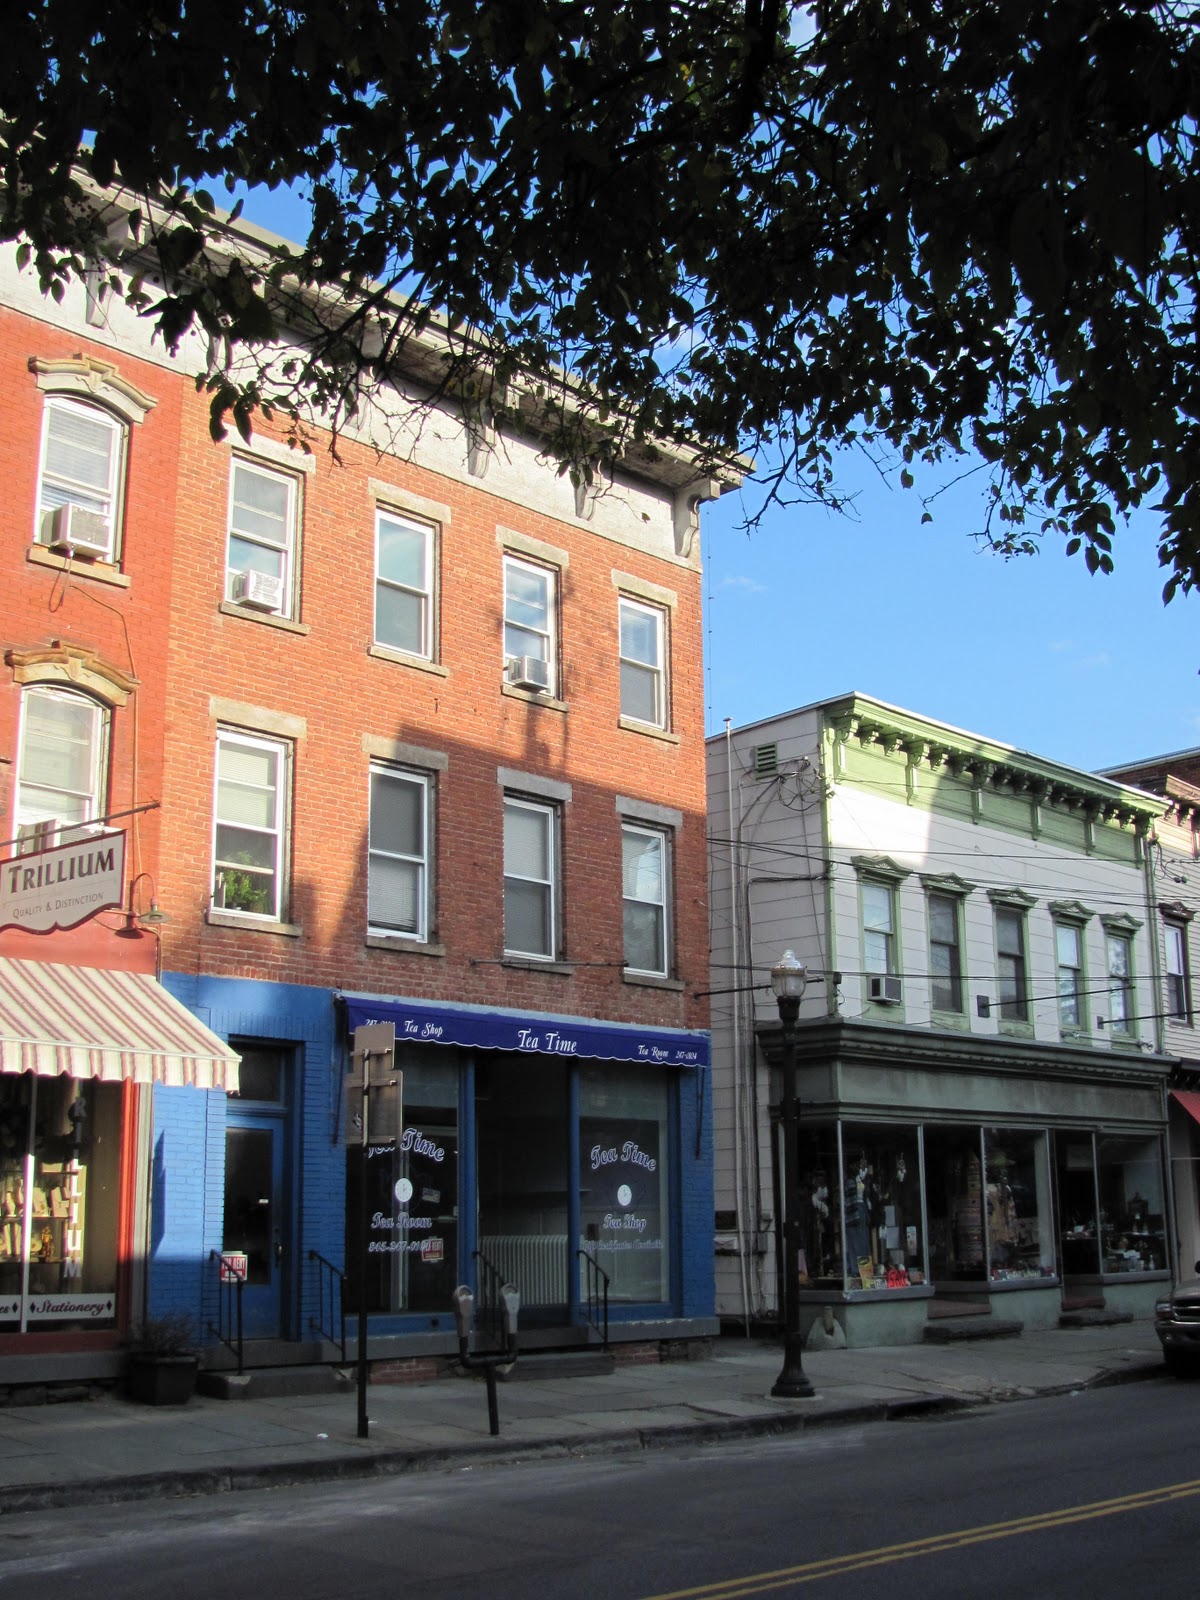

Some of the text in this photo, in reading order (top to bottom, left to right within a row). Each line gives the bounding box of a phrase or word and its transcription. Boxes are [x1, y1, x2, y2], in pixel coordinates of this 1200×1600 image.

[46, 902, 53, 912] &
[404, 1019, 419, 1033] Tea
[421, 1022, 444, 1038] Shop
[517, 1028, 577, 1053] Tea Time
[637, 1044, 649, 1056] Tea
[651, 1046, 669, 1060] Room
[402, 1128, 444, 1161] Time
[590, 1140, 657, 1172] Tea Time
[370, 1211, 433, 1229] Tea Room
[604, 1213, 646, 1232] Tea Shop
[36, 1299, 106, 1317] Stationery
